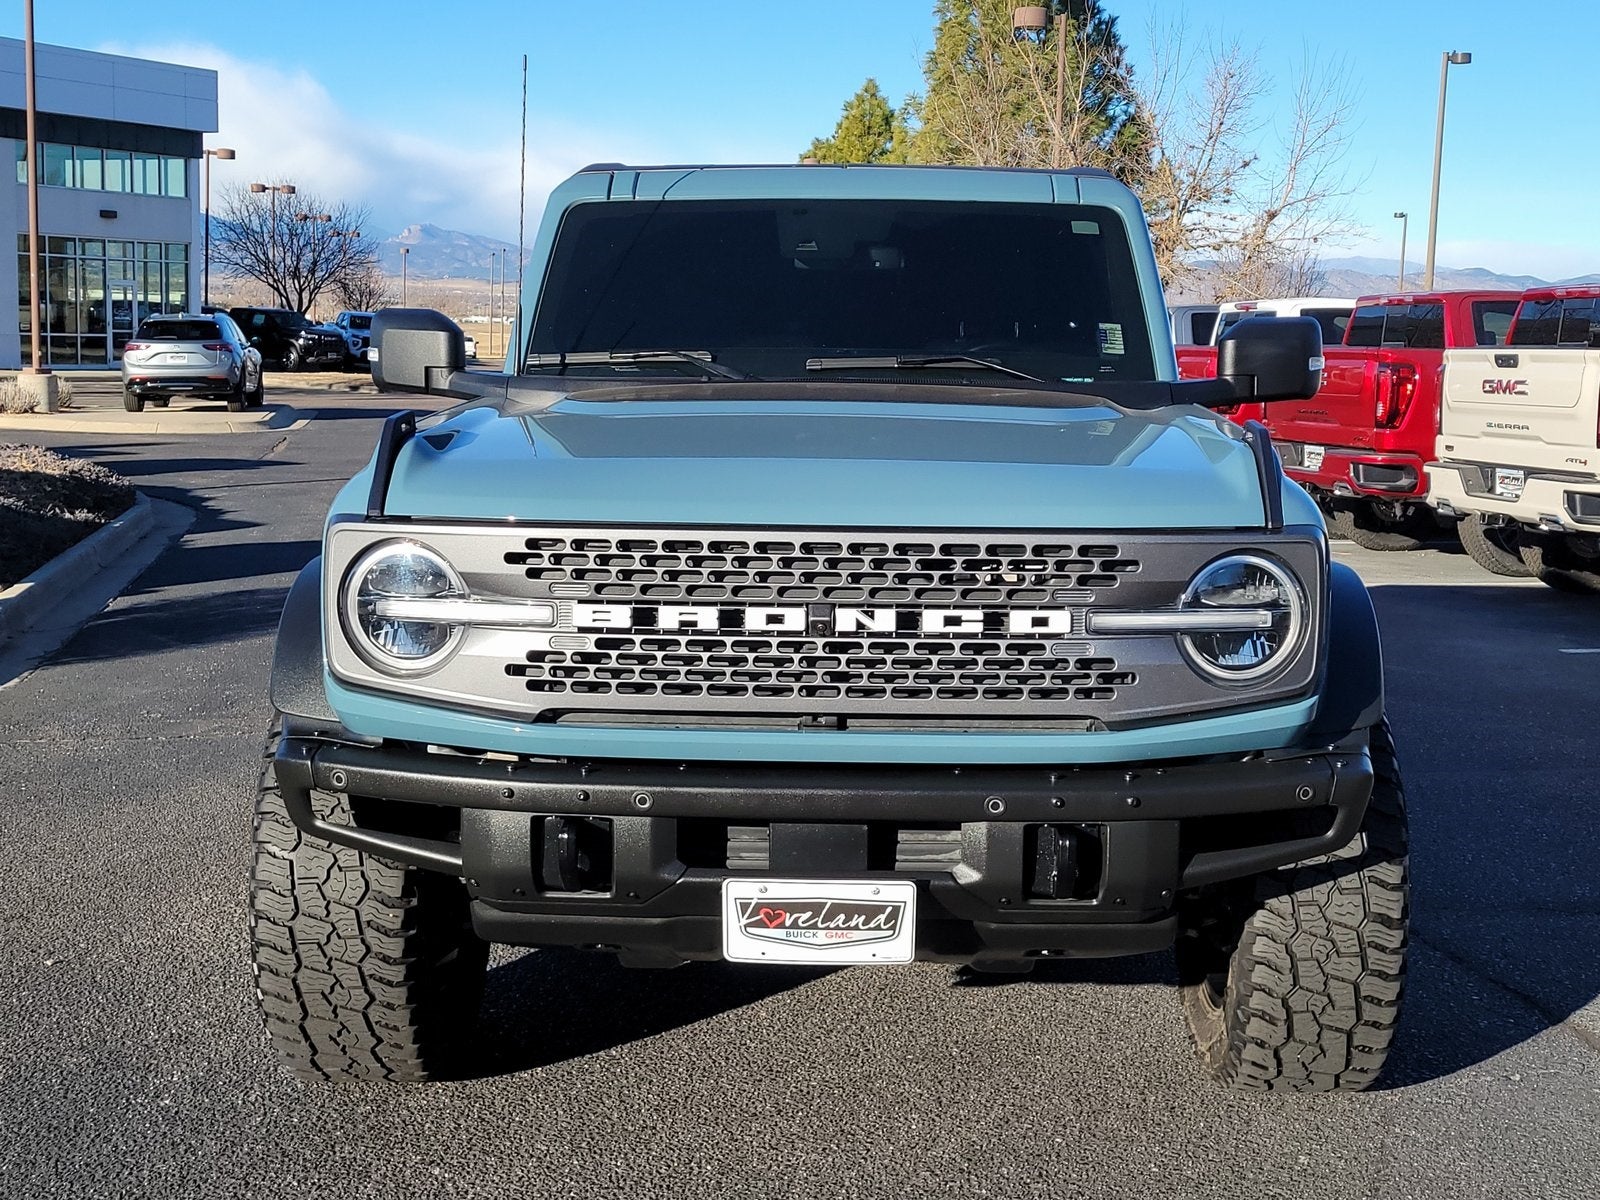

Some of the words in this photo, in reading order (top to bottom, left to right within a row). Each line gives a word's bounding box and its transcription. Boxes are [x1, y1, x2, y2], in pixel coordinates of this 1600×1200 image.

[1482, 379, 1529, 396] GMC
[1486, 421, 1530, 431] SIERRA
[1565, 457, 1588, 466] AT4
[572, 604, 1071, 633] BRONCO
[785, 930, 819, 939] BUICK
[824, 931, 854, 939] GMC
